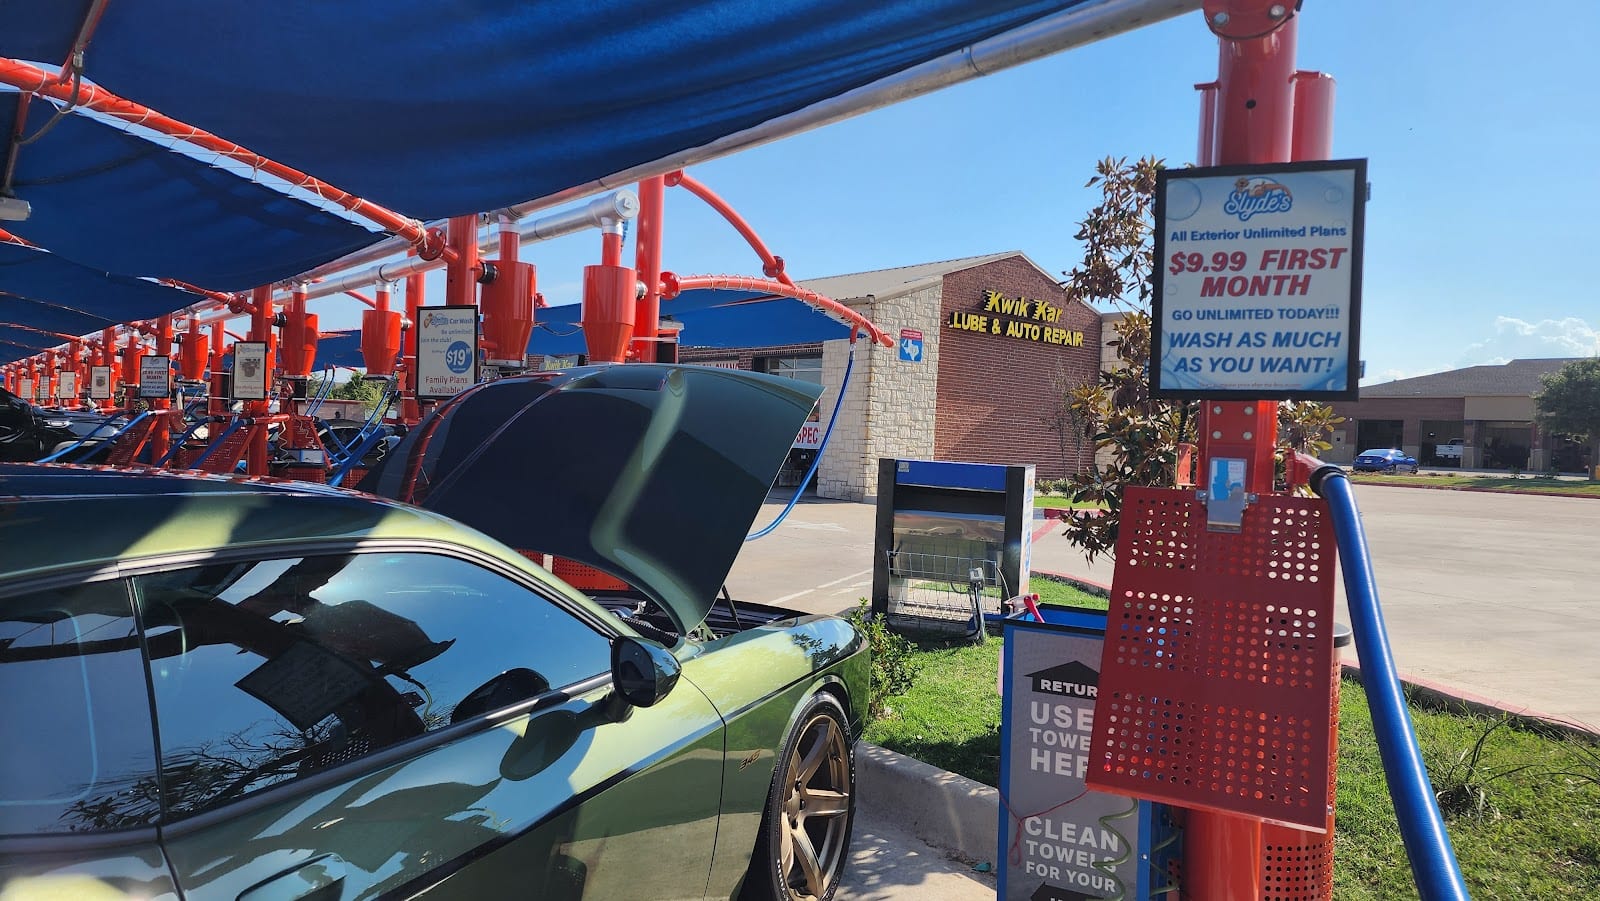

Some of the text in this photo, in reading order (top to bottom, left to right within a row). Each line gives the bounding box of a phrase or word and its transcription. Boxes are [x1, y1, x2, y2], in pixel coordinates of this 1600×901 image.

[1224, 190, 1292, 221] Slyde's
[1171, 226, 1347, 242] All Exterior Unlimited Plans
[1169, 248, 1347, 275] $9.99 FIRST
[1200, 274, 1312, 297] MONTH
[984, 289, 1063, 323] Kwik Kar
[1172, 308, 1340, 321] GO UNLIMITED TODAY!!!
[953, 312, 1084, 347] LUBE & AUTO REPAIR
[1170, 331, 1342, 348] WASH AS MUCH
[446, 349, 466, 366] $19
[1173, 357, 1334, 373] AS YOU WANT!
[425, 376, 468, 384] Family Plans
[796, 426, 820, 444] SPEC
[1040, 679, 1098, 697] RETUR
[1031, 701, 1095, 731] USE
[1029, 727, 1092, 749] TOWE
[1024, 816, 1119, 852] CLEAN
[1025, 840, 1117, 873] TOWELS
[1025, 861, 1116, 893] FOR YOUR
